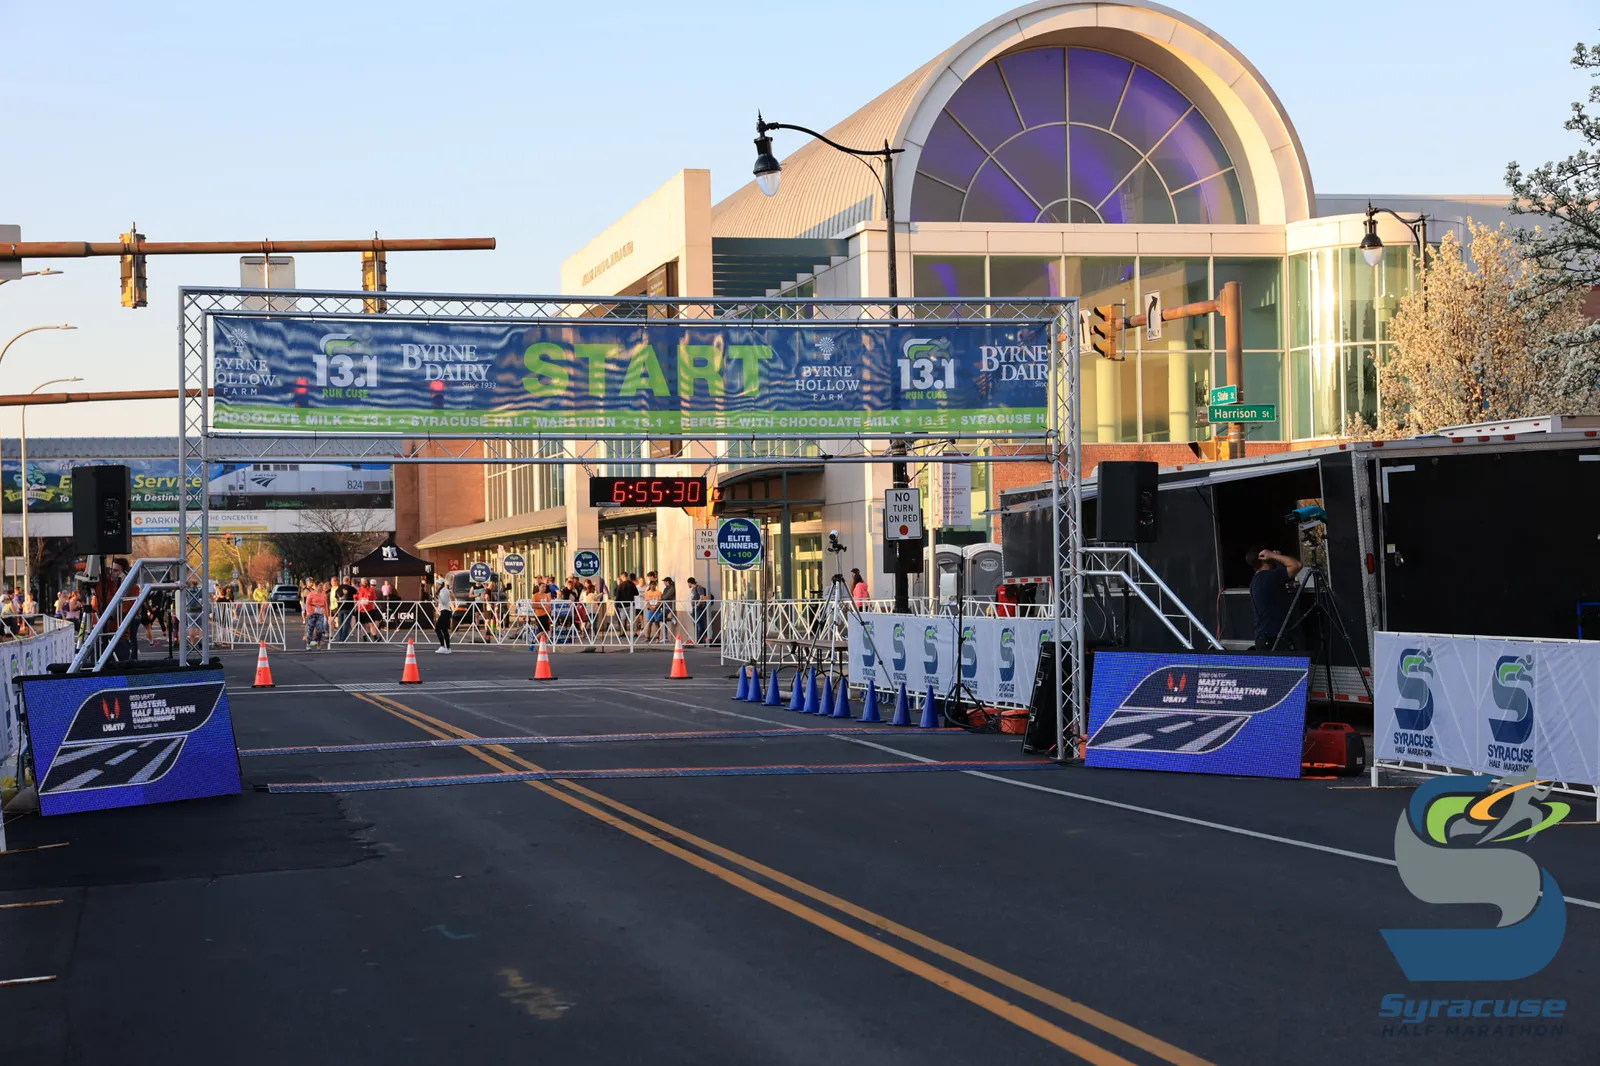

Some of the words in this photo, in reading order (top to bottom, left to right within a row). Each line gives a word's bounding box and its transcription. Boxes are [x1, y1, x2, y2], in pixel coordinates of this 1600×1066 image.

[1148, 329, 1160, 338] ONLY
[400, 344, 478, 371] BYRNE
[979, 345, 1049, 372] BYRNE
[215, 357, 268, 371] BYRNE
[313, 354, 377, 387] 13.1
[424, 363, 492, 381] DAIRY
[523, 342, 773, 397] START
[802, 365, 853, 379] BYRNE
[897, 358, 955, 390] 13.1
[1001, 363, 1048, 381] DAIR
[216, 372, 277, 387] OLLOW
[461, 381, 479, 390] Since
[480, 382, 496, 390] 1933
[795, 379, 860, 392] HOLLOW
[223, 387, 259, 396] FARM
[322, 388, 343, 398] RUN
[346, 388, 369, 398] CUSE
[905, 391, 924, 400] RUN
[813, 394, 845, 402] FARM
[1214, 409, 1257, 419] Harrison
[1262, 410, 1270, 418] St
[306, 415, 343, 426] MILK
[362, 415, 392, 426] 13.1
[411, 415, 488, 427] SYRACUSE
[494, 416, 530, 428] HALF
[536, 416, 616, 428] MARATHON
[633, 416, 662, 428] 13.1
[681, 416, 733, 428] REFUEL
[739, 416, 777, 428] WITH
[779, 416, 861, 428] CHOCOLATE
[866, 415, 900, 427] MILK
[916, 415, 946, 427] 13.1
[961, 413, 1032, 426] SYRACUSE
[347, 480, 363, 490] 824
[59, 495, 69, 503] To
[144, 493, 203, 502] Destinaon!
[895, 492, 910, 502] NO
[892, 504, 914, 513] TURN
[145, 517, 181, 525] PARKIN
[889, 515, 901, 523] ON
[902, 514, 918, 523] RED
[727, 535, 751, 543] ELITE
[719, 542, 760, 550] RUNNERS
[576, 560, 583, 569] 9
[588, 560, 599, 568] 11
[1198, 679, 1238, 687] MASTERS
[1197, 686, 1219, 694] HALF
[1220, 687, 1268, 696] MARATHON
[131, 700, 167, 709] MASTERS
[132, 709, 152, 717] HALF
[153, 705, 195, 715] MARATHON
[103, 723, 125, 731] USATF
[1393, 732, 1434, 749] SYRACUSE
[1394, 745, 1406, 754] HALF
[1407, 748, 1432, 758] MARATHON
[1487, 744, 1534, 763] SYRACUSE
[1488, 760, 1500, 769] HALF
[1503, 762, 1529, 773] MARATHO
